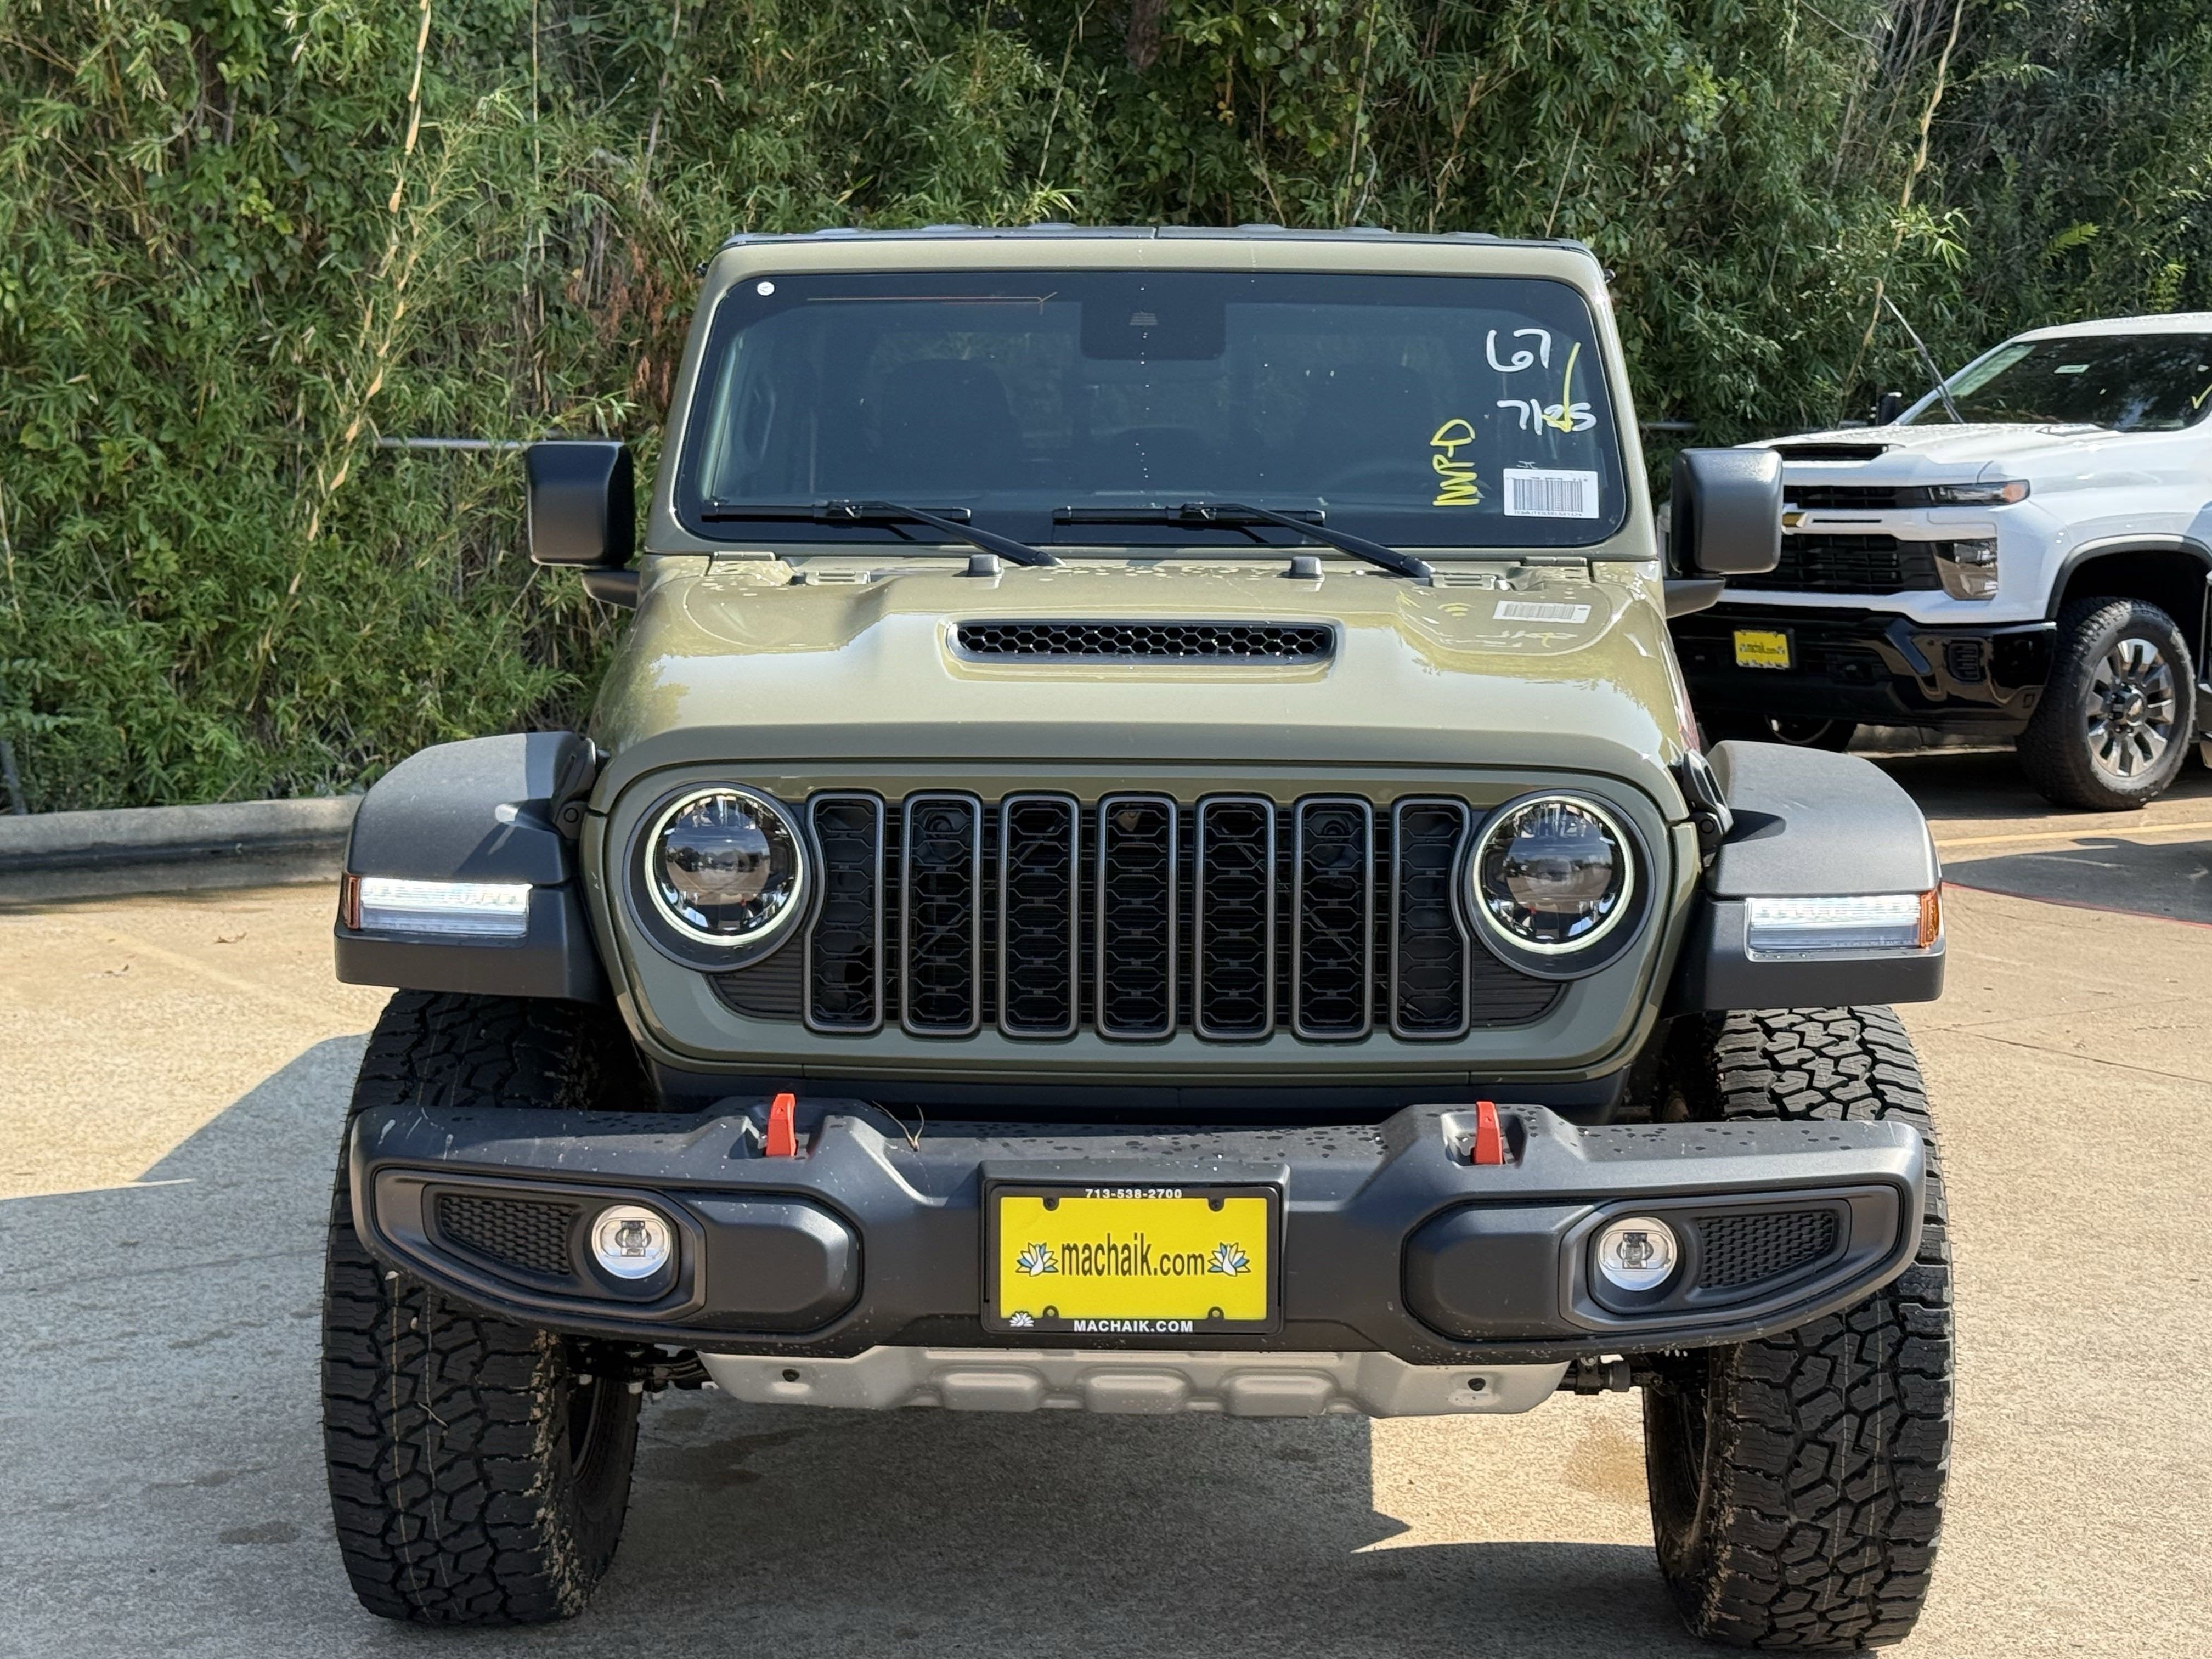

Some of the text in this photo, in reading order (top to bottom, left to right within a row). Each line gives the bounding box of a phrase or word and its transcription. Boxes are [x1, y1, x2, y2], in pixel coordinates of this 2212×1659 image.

[1085, 1188, 1182, 1199] 713-538-2700
[1061, 1232, 1205, 1276] machaik.com
[1074, 1320, 1193, 1333] MACHAIK.COM
